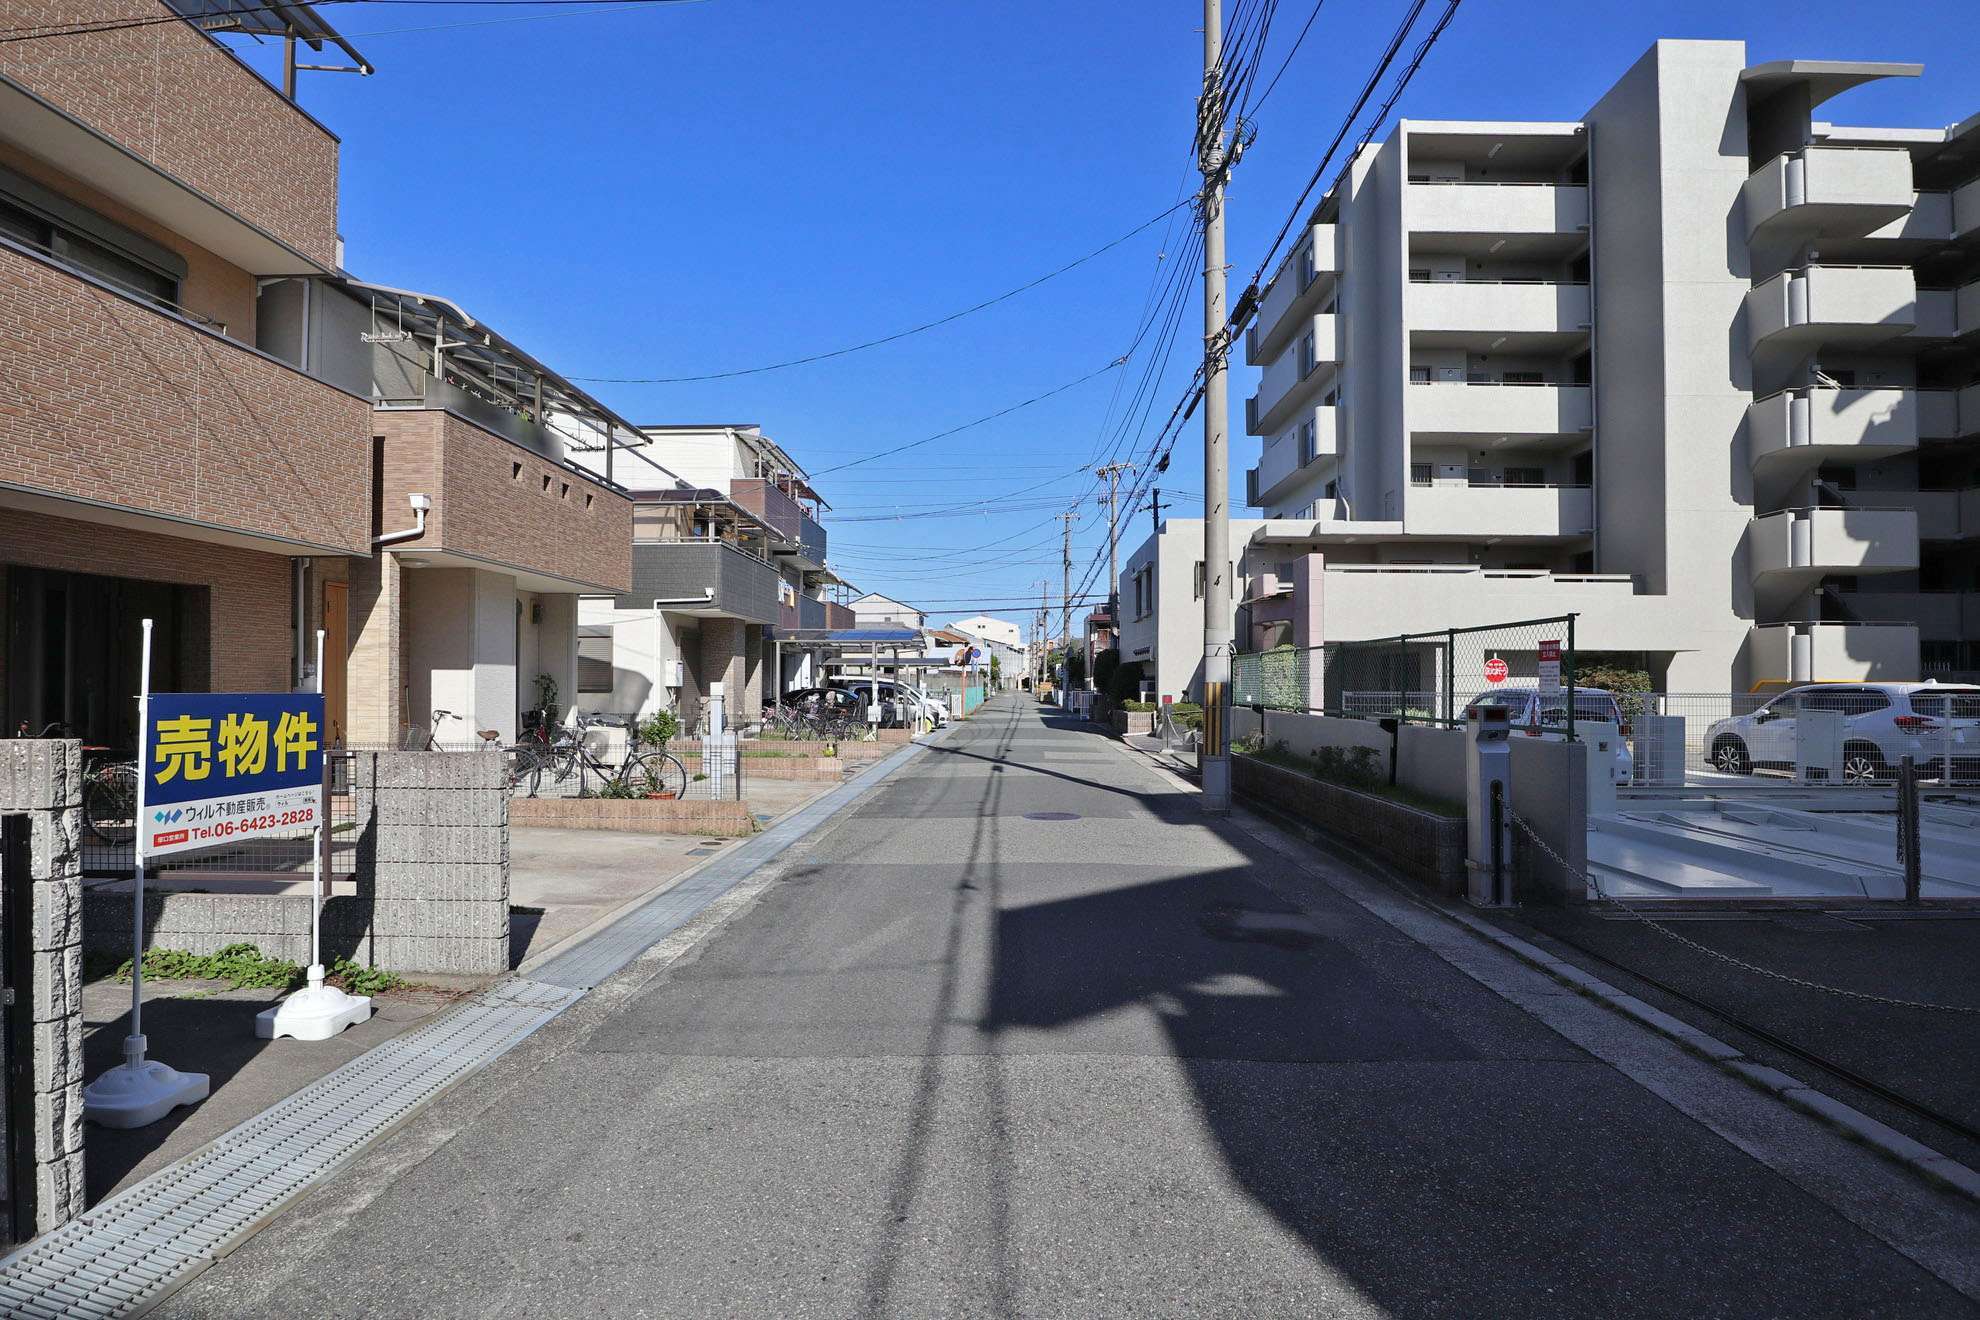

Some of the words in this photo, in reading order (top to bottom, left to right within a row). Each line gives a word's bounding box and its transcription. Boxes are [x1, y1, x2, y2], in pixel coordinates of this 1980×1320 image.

[154, 711, 317, 785] 売物件
[185, 797, 266, 822] ウィル不動産販売
[192, 808, 314, 840] Tel.06-6423-2828
